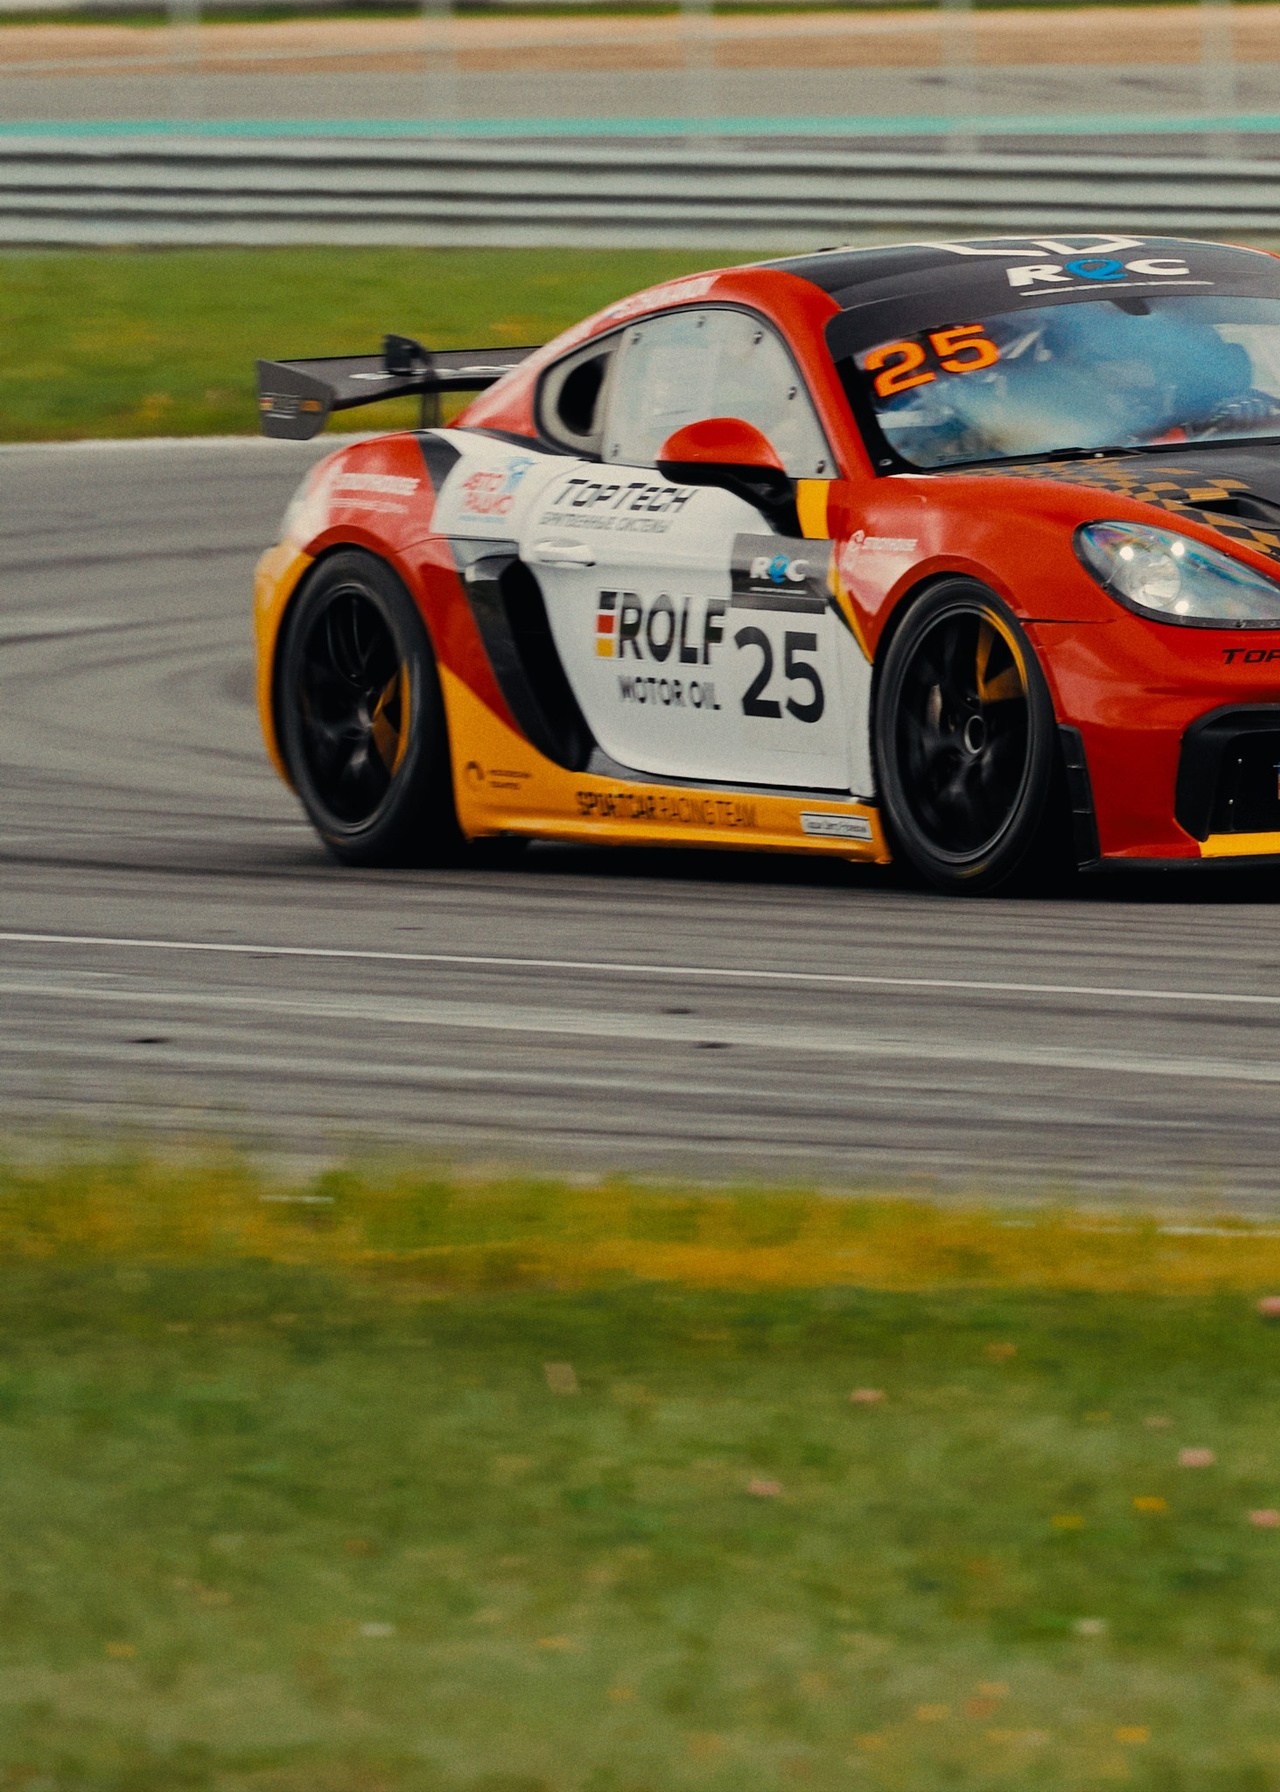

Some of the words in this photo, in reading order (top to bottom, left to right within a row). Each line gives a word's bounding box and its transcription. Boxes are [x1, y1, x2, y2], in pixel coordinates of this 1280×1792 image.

[863, 324, 1000, 398] 25
[619, 590, 729, 665] ROLF
[618, 675, 685, 706] MOTOR
[689, 680, 721, 710] OIL
[734, 626, 825, 723] 25
